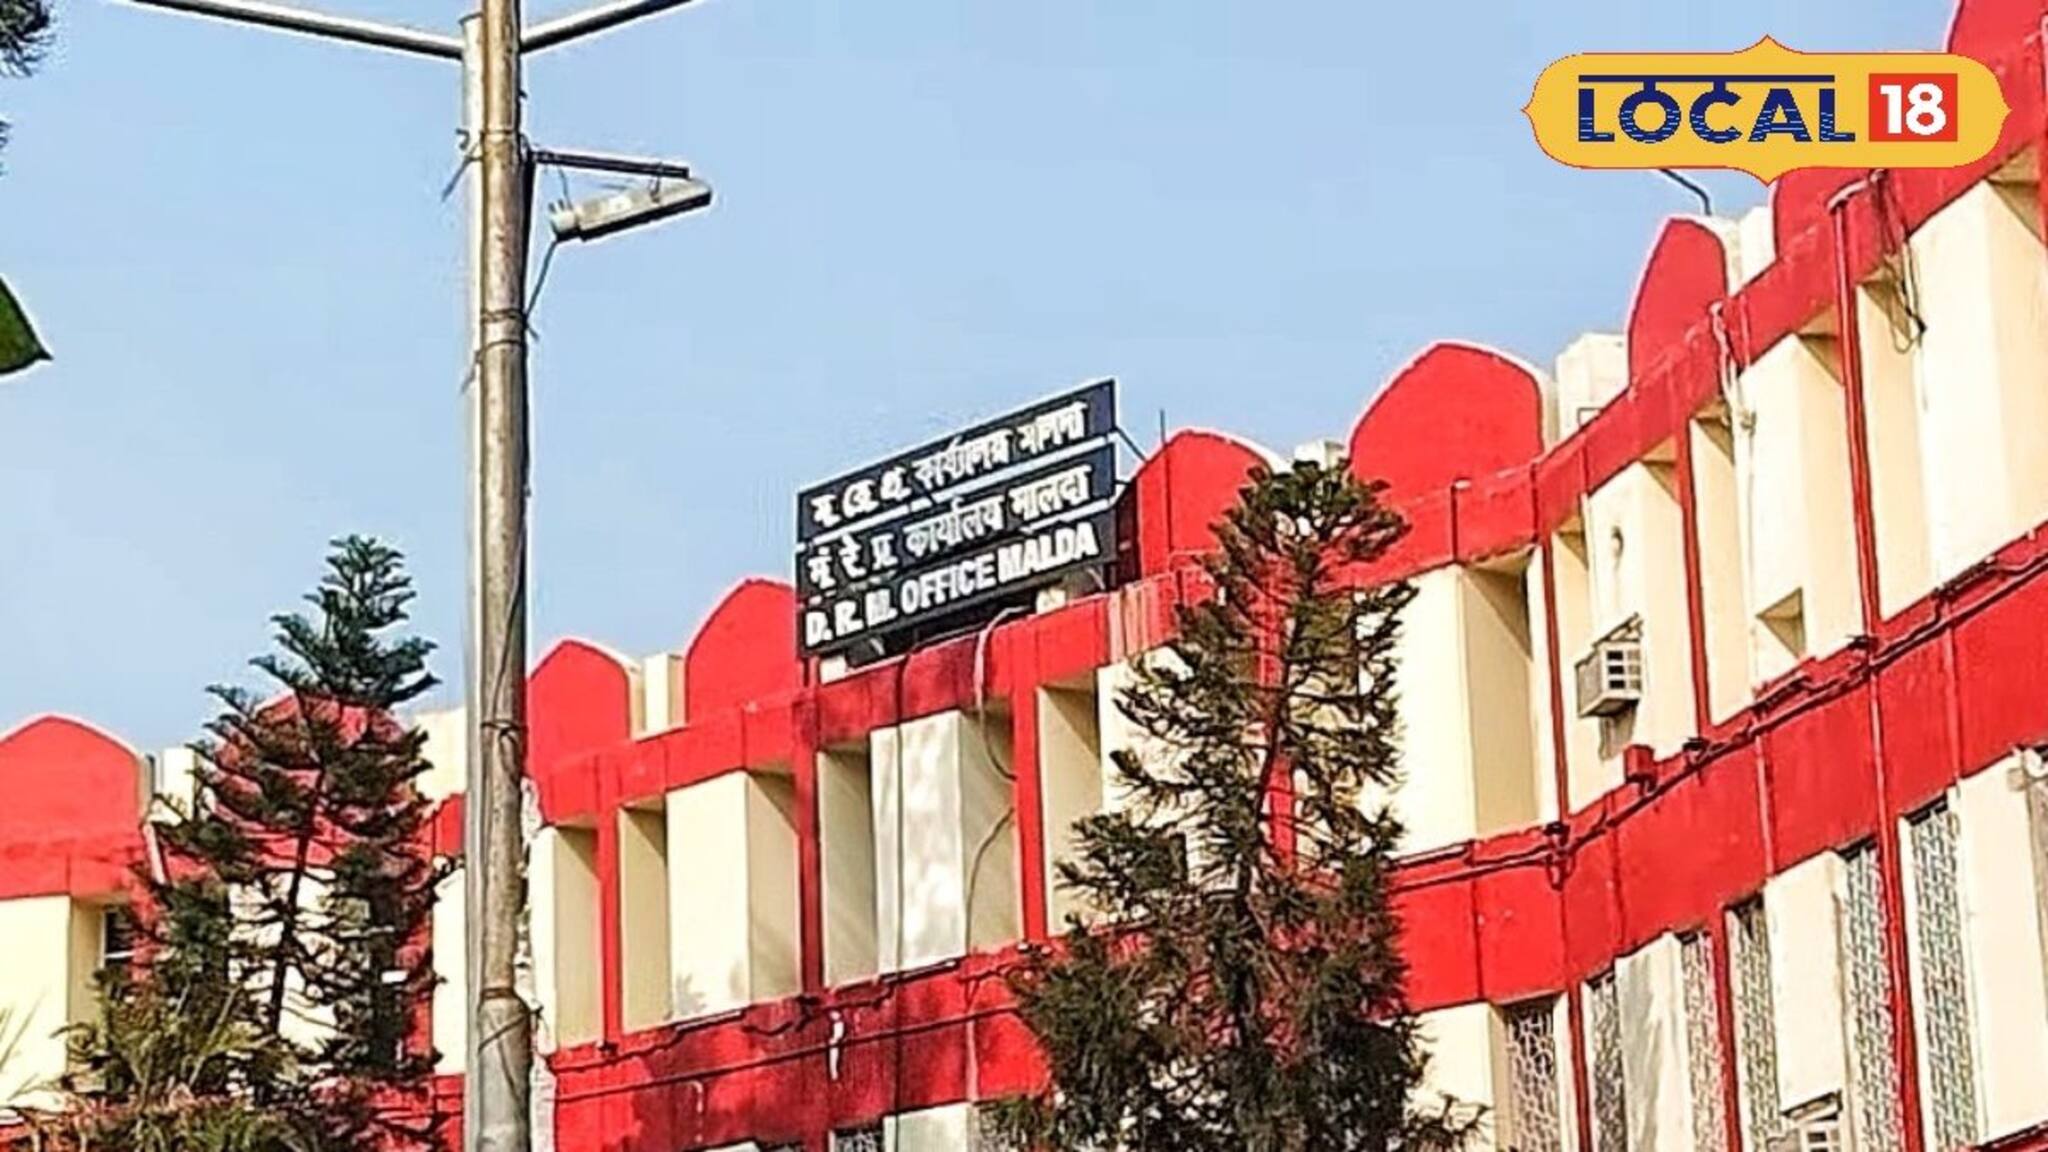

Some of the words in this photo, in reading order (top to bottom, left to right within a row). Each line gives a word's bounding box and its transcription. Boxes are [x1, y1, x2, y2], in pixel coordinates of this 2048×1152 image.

[903, 496, 1005, 557] कार्यालय
[1009, 464, 1092, 522] मालदा
[901, 553, 997, 613] OFFICE
[997, 521, 1099, 583] MALDA
